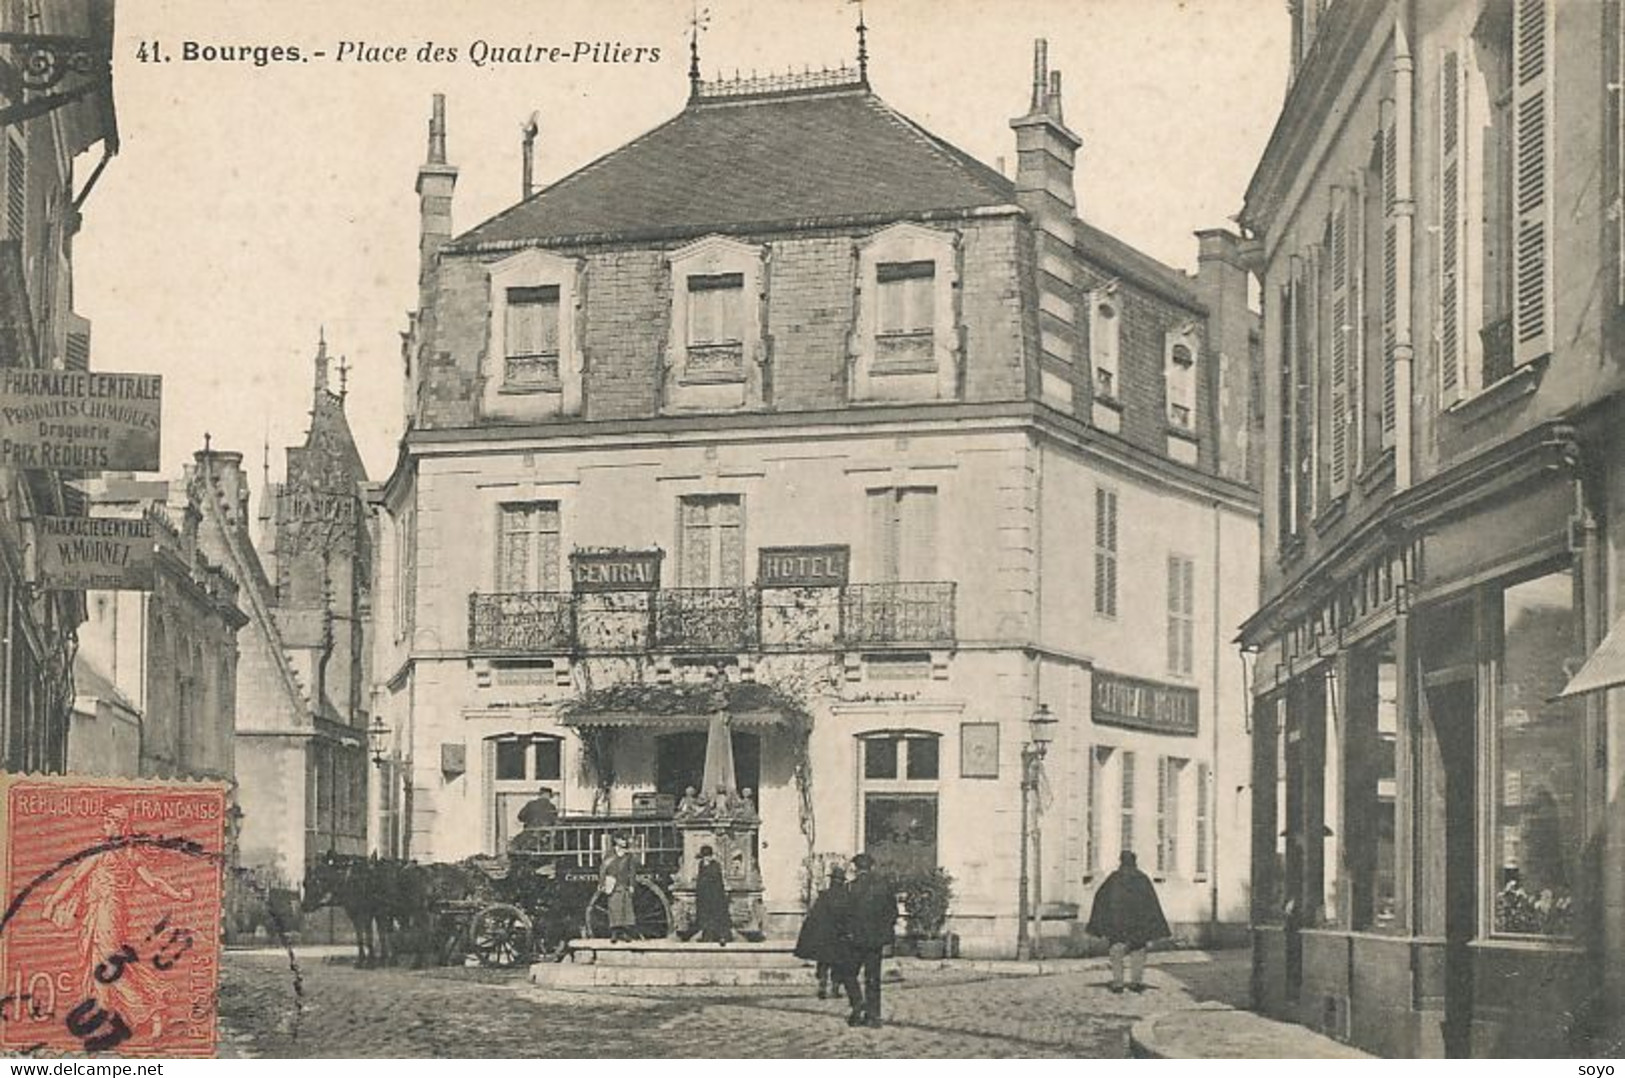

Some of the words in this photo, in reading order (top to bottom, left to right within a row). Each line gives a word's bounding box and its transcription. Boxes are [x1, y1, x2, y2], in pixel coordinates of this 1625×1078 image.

[4, 373, 86, 397] PHARMACIE
[88, 374, 161, 399] CENTRALE
[3, 399, 79, 426] PRODUITS
[39, 421, 110, 444] Droguerie
[3, 439, 38, 466] PRIX
[575, 562, 655, 584] CENTRAL
[765, 555, 841, 579] HOTEL
